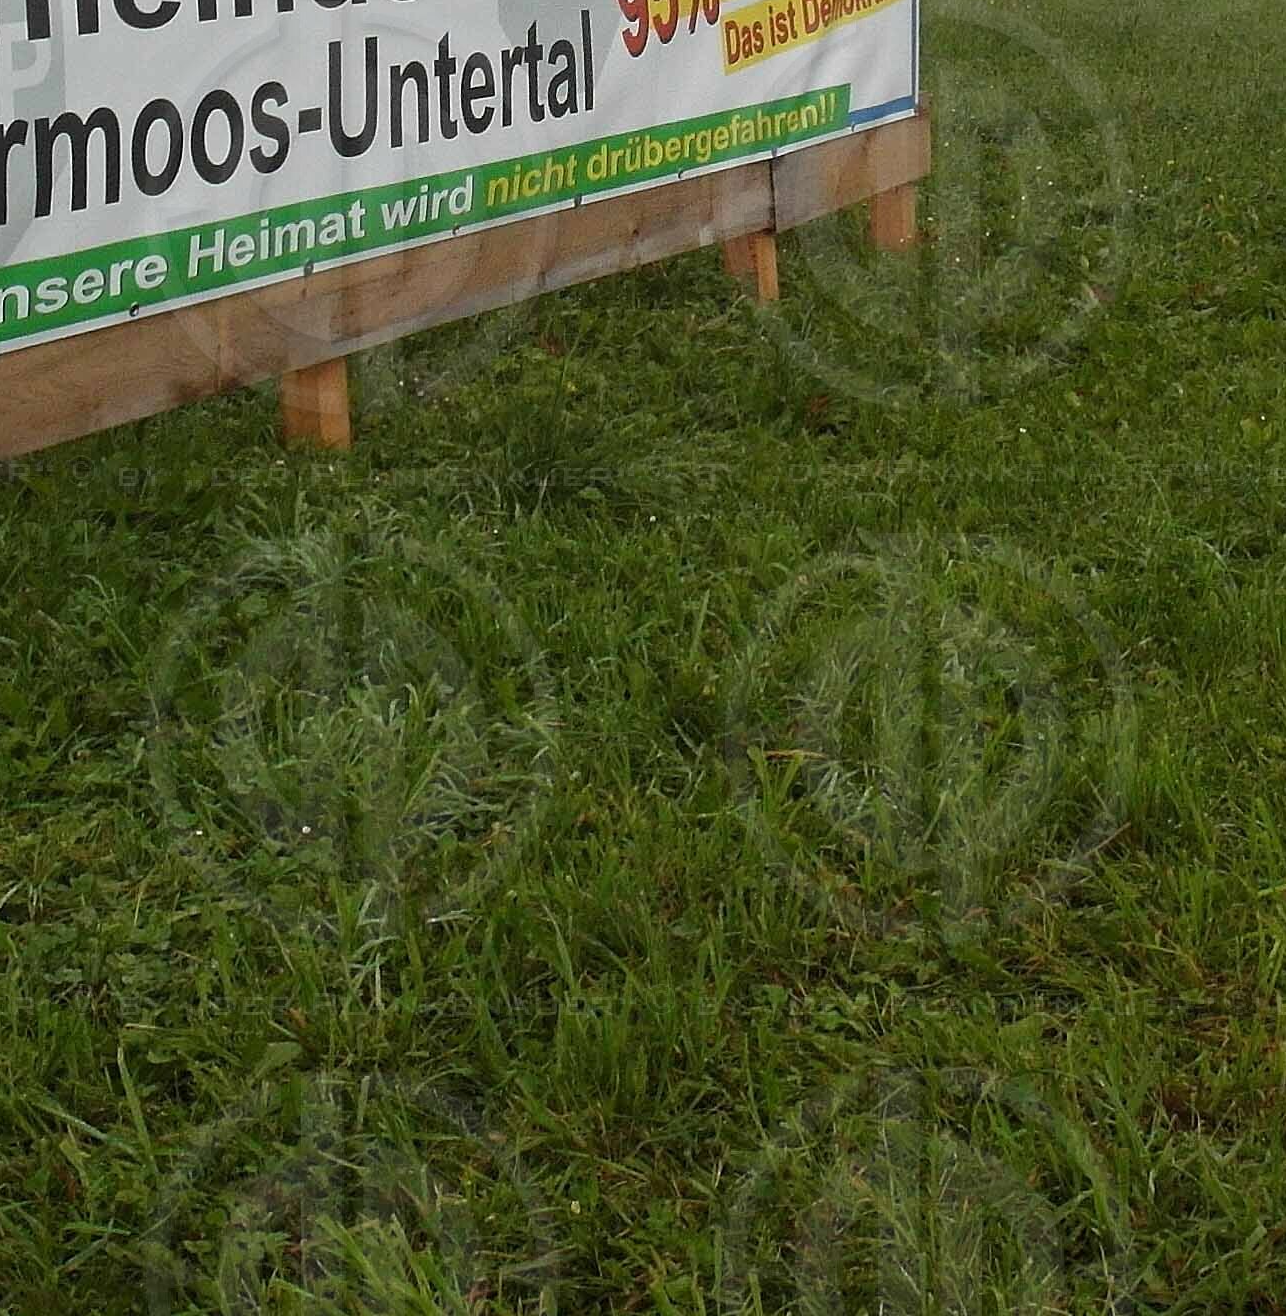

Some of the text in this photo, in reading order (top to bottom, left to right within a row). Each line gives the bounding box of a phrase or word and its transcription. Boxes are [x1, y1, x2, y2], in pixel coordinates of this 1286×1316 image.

[724, 17, 765, 66] Das
[769, 1, 798, 47] ist
[186, 201, 365, 278] Heimat
[381, 179, 474, 230] wird
[486, 153, 578, 208] nicht
[586, 92, 837, 182] drübergefahren!!
